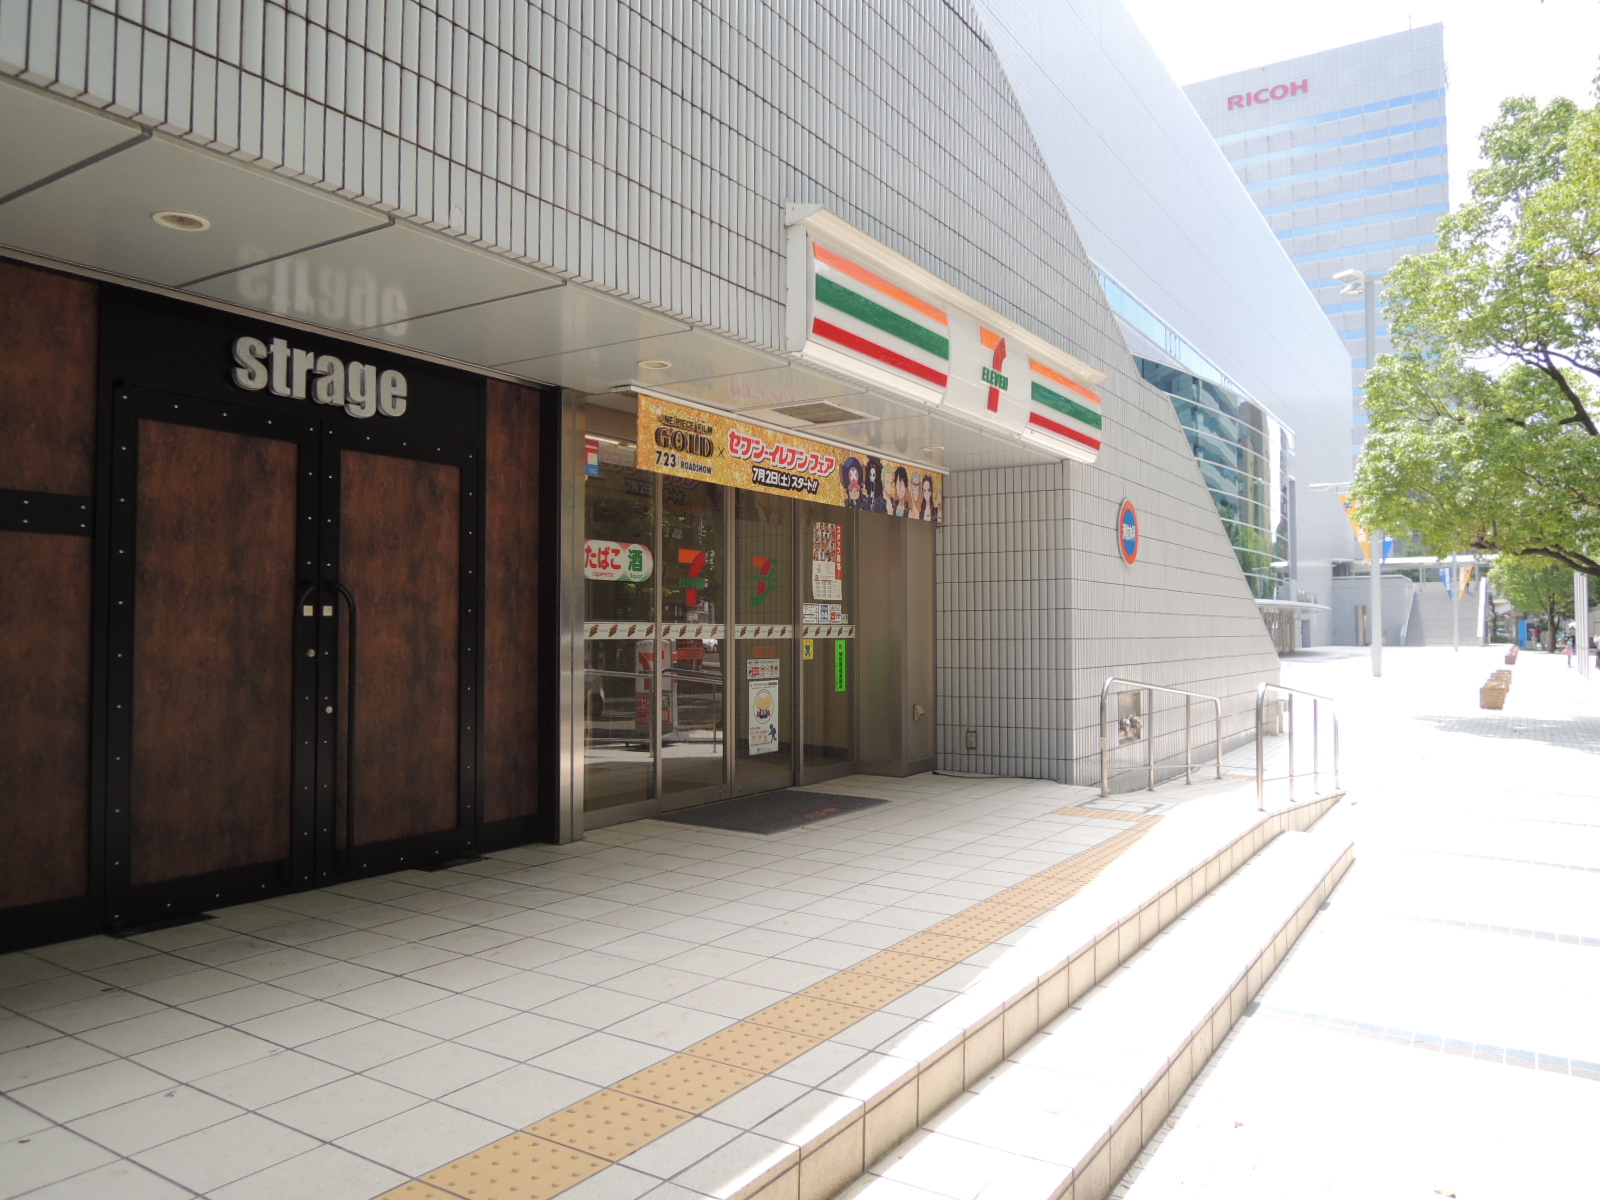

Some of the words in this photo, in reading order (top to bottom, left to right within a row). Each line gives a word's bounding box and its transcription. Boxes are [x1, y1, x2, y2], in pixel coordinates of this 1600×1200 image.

[1227, 78, 1309, 111] RICOH
[232, 336, 408, 419] strage
[980, 326, 1007, 413] 7
[675, 418, 695, 430] PIECE
[697, 423, 713, 434] FILM
[655, 427, 714, 458] GOLD
[656, 450, 677, 468] 7.23
[680, 460, 713, 475] ROADSHOW
[585, 545, 622, 570] たばこ
[628, 549, 643, 572] 酒
